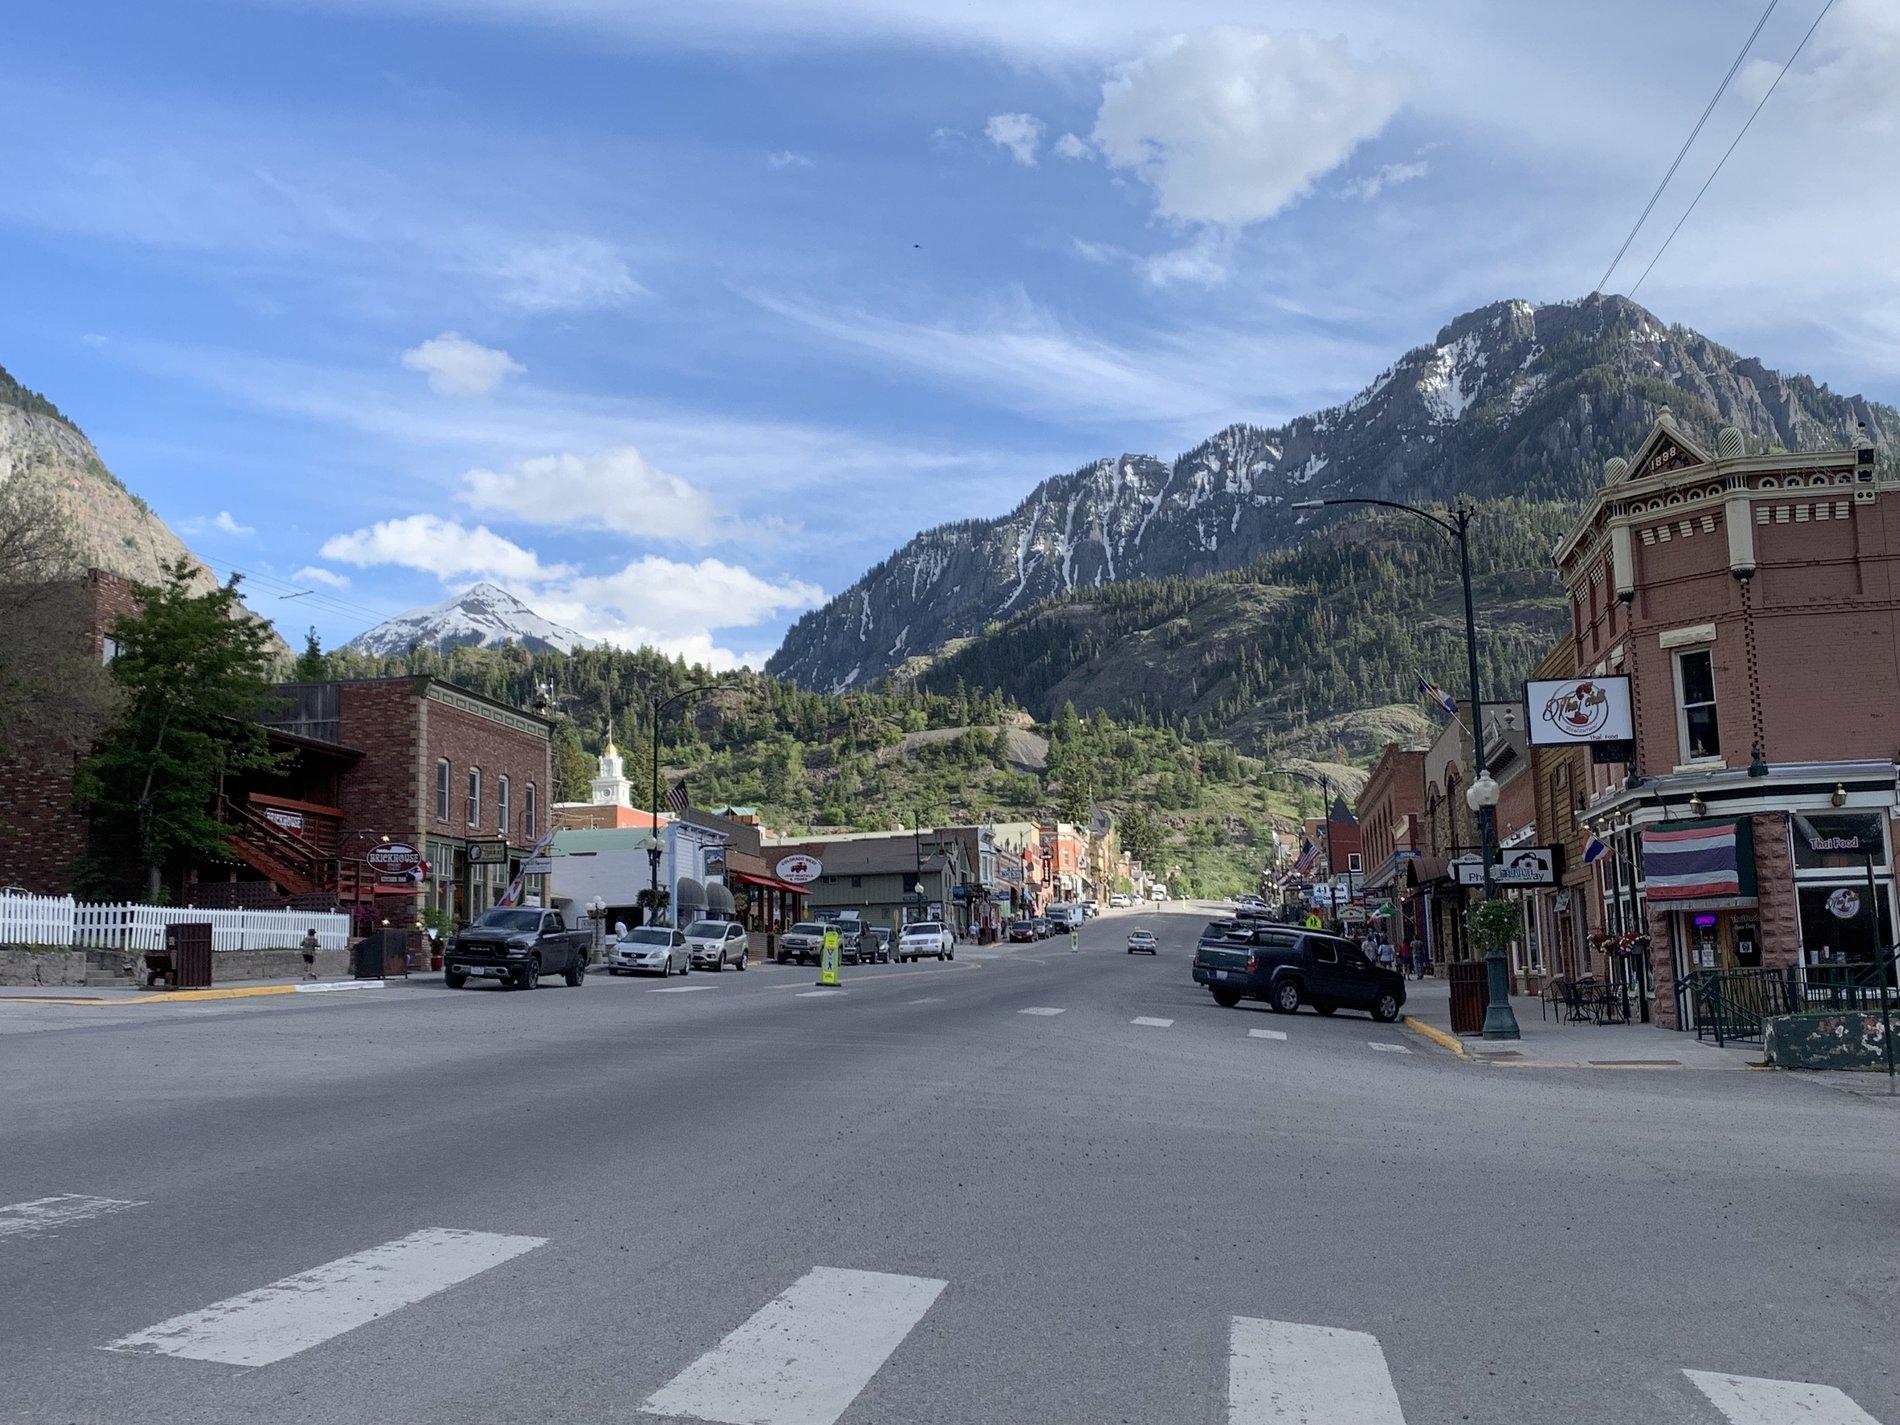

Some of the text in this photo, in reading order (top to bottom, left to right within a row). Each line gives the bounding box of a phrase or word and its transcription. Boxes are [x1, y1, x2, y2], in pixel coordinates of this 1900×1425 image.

[1651, 446, 1676, 470] 1898
[1809, 836, 1859, 850] Thai Food
[370, 853, 418, 863] BRICKHOUSE
